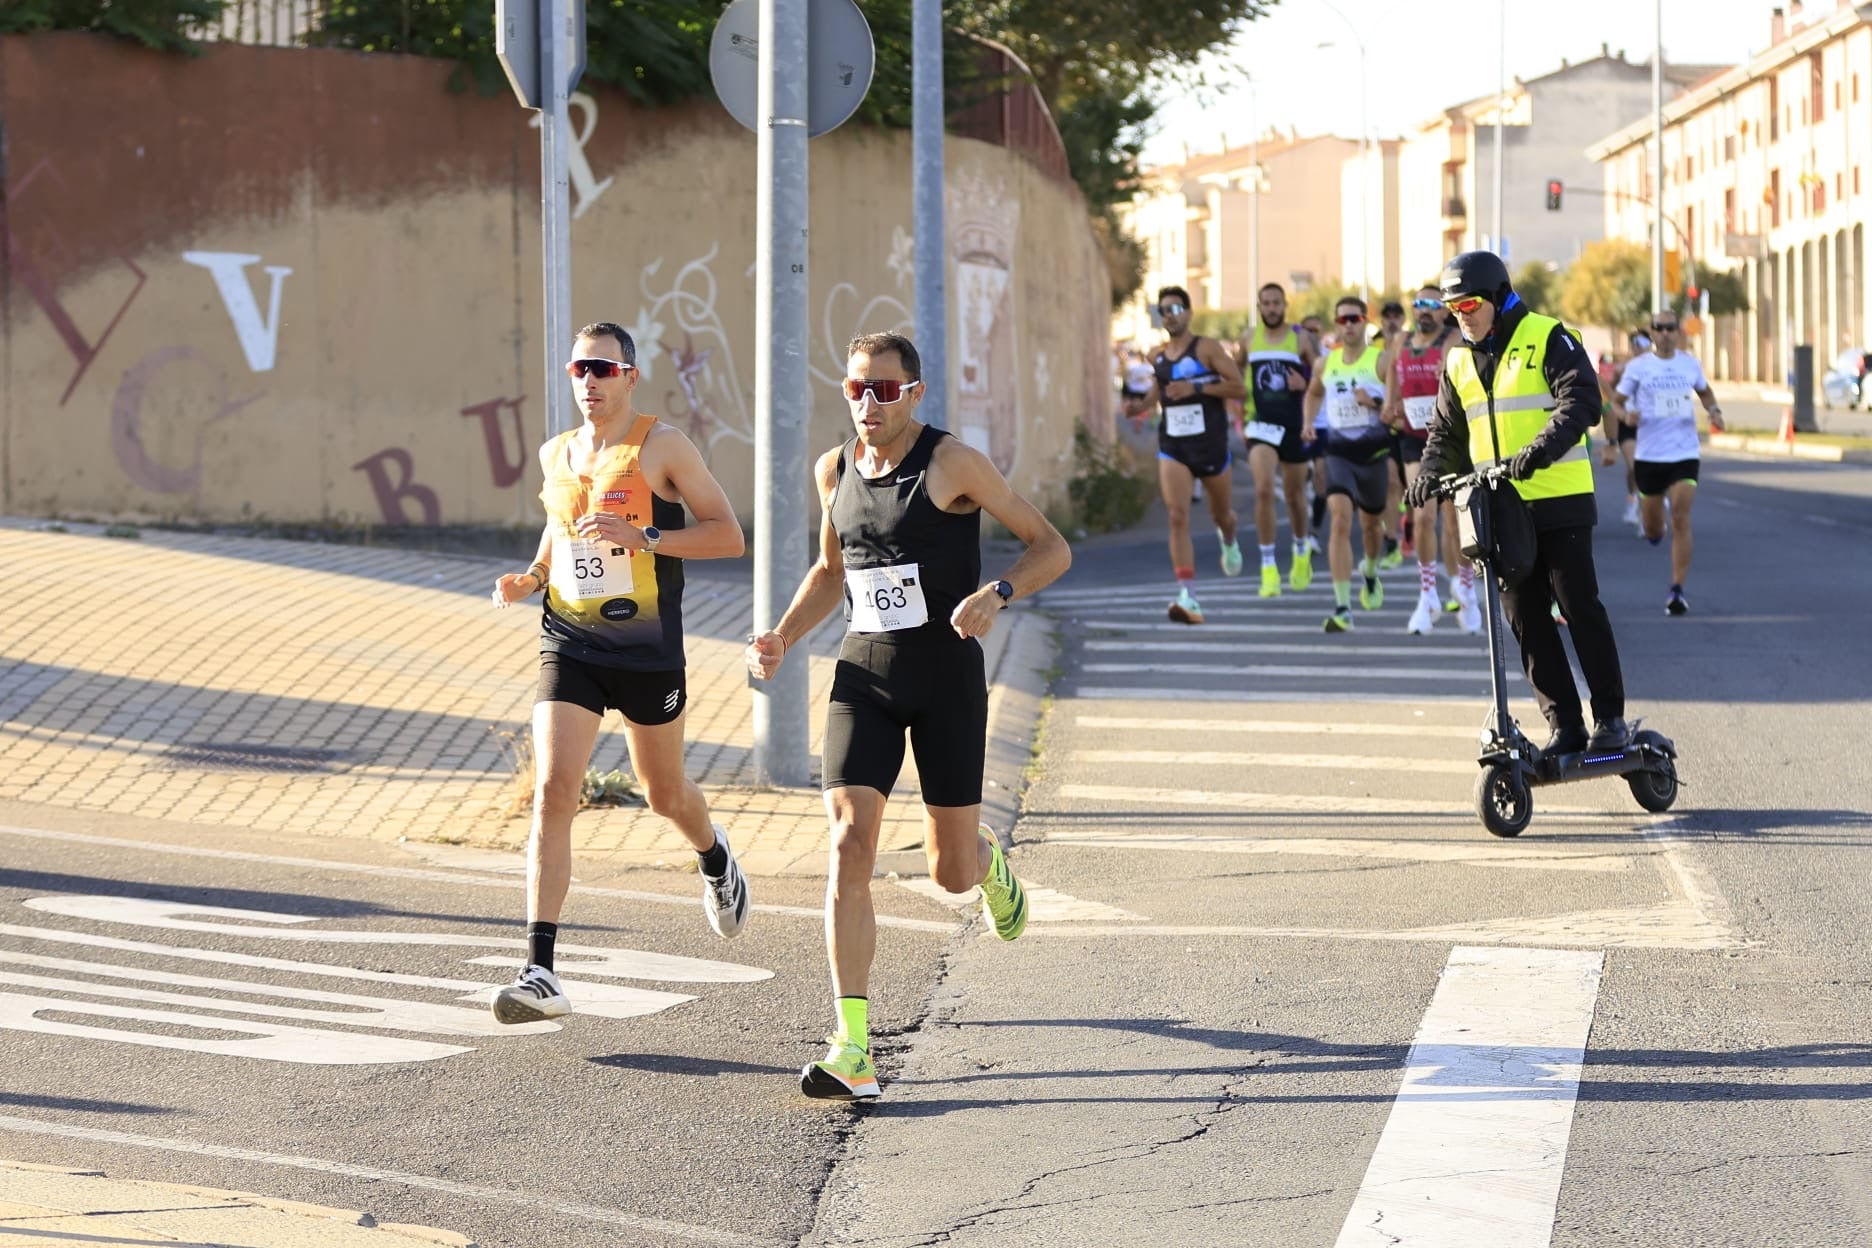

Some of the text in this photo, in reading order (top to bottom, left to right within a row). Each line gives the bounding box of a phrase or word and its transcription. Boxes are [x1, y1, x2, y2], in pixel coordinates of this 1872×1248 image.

[182, 251, 293, 372] V
[460, 395, 528, 489] U
[575, 557, 605, 580] 53
